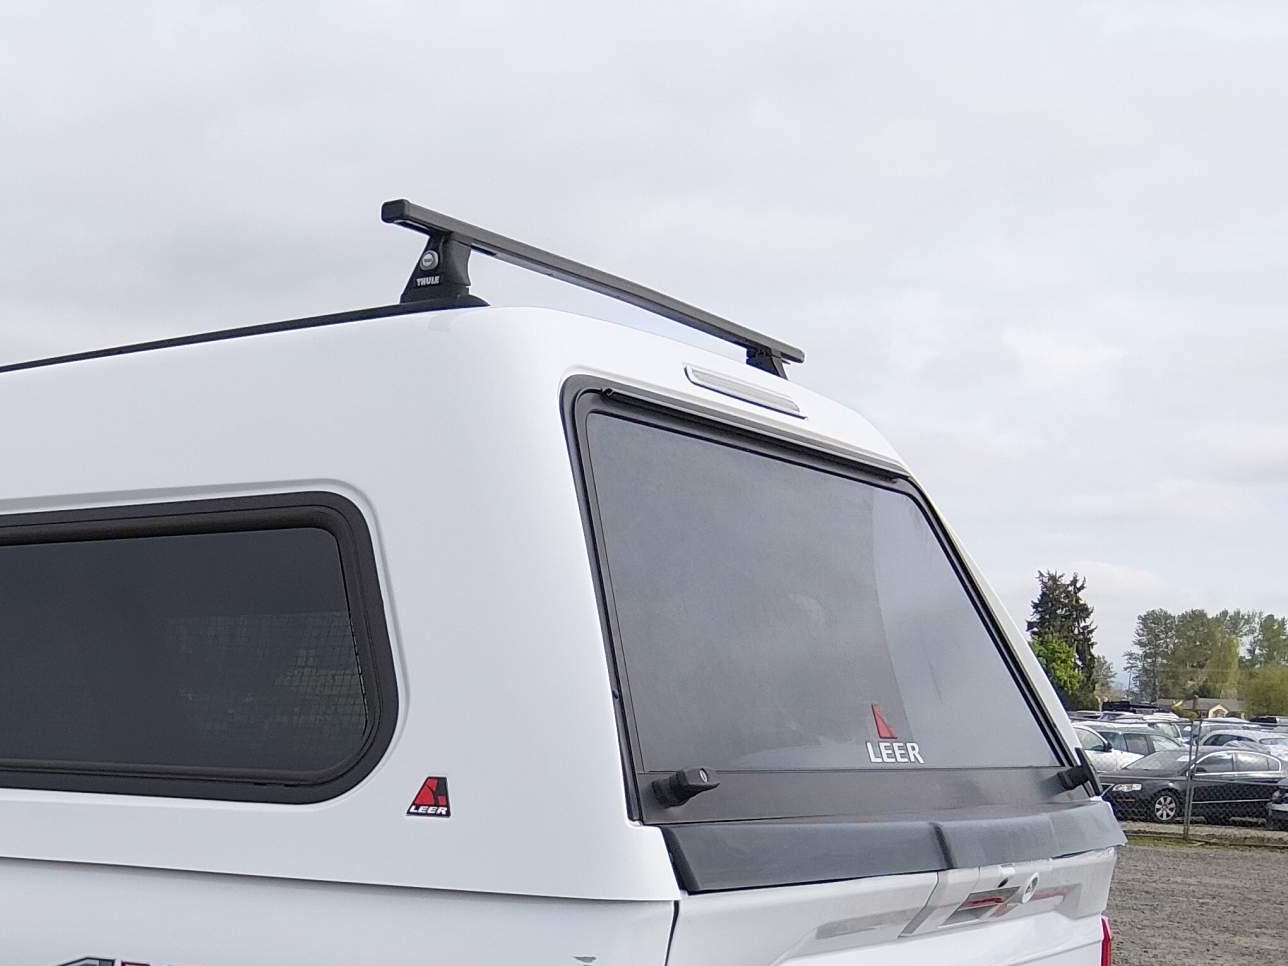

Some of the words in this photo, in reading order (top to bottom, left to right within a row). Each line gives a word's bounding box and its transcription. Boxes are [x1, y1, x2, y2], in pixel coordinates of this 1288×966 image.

[415, 275, 440, 287] THULE
[865, 741, 925, 764] LEER
[409, 804, 448, 815] LEER
